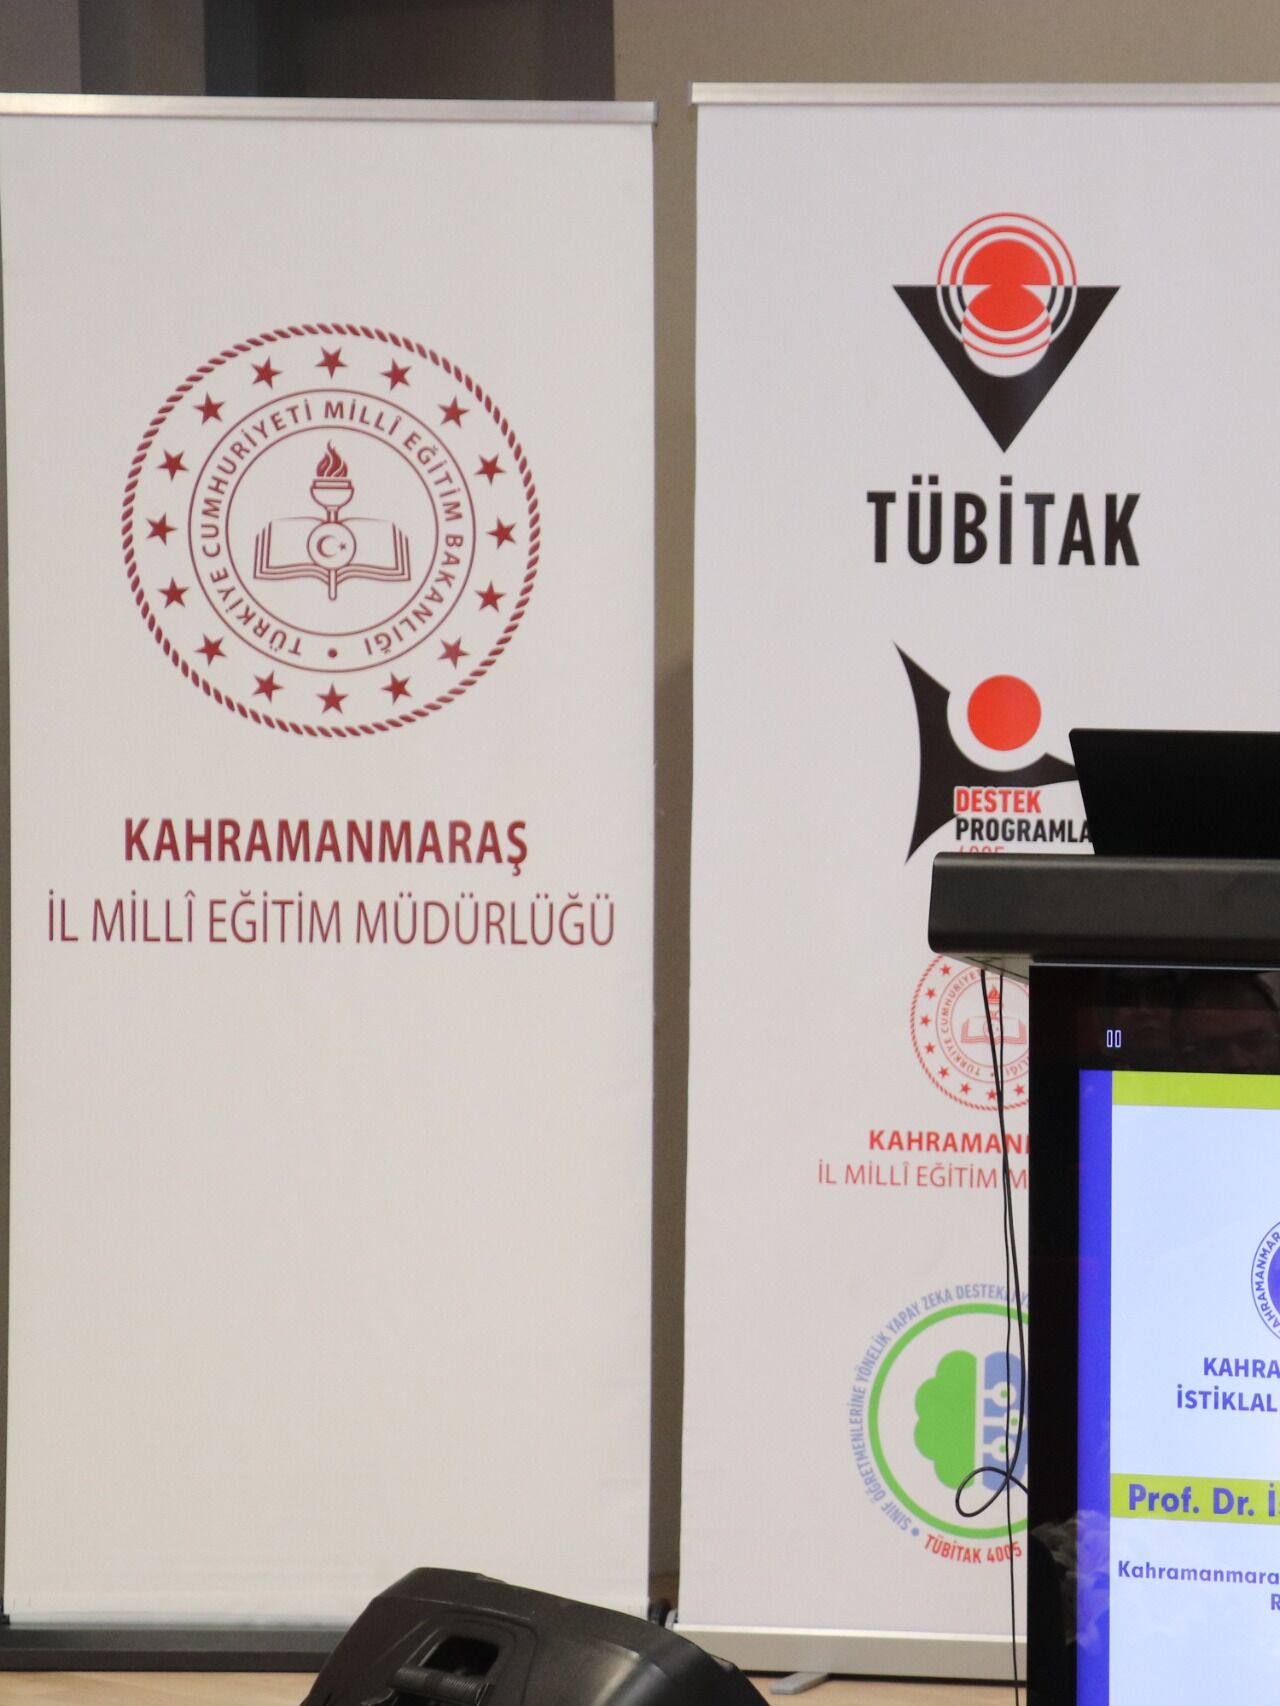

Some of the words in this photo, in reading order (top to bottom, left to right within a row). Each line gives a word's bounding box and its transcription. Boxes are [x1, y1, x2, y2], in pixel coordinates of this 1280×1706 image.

[202, 397, 313, 559] CUMHURİYETİ
[403, 430, 465, 522] EĞİTİM
[866, 473, 1141, 567] TÜBİTAK
[364, 532, 464, 656] BAKANLIĞI
[209, 566, 302, 657] TÜRKİYE
[955, 788, 1041, 814] DESTEK
[956, 817, 1093, 843] PROGRAMLA
[123, 817, 529, 877] KAHRAMANMARAŞ
[47, 889, 79, 944] İL
[208, 889, 342, 946] EĞİTİM
[355, 890, 616, 947] MÜDÜRLÜĞÜ
[869, 1129, 1029, 1155] KAHRAMAN
[818, 1159, 837, 1185] İL
[916, 1161, 997, 1189] EĞİTİM
[923, 1287, 953, 1311] ZEKA
[886, 1300, 922, 1334] YAPAY
[1176, 1384, 1278, 1414] İSTİKLAL
[881, 1499, 912, 1532] SINIF
[1128, 1483, 1200, 1514] Prof.
[1212, 1487, 1254, 1516] Dr.
[925, 1533, 982, 1564] TÜBİTAK
[987, 1540, 1022, 1562] 4005
